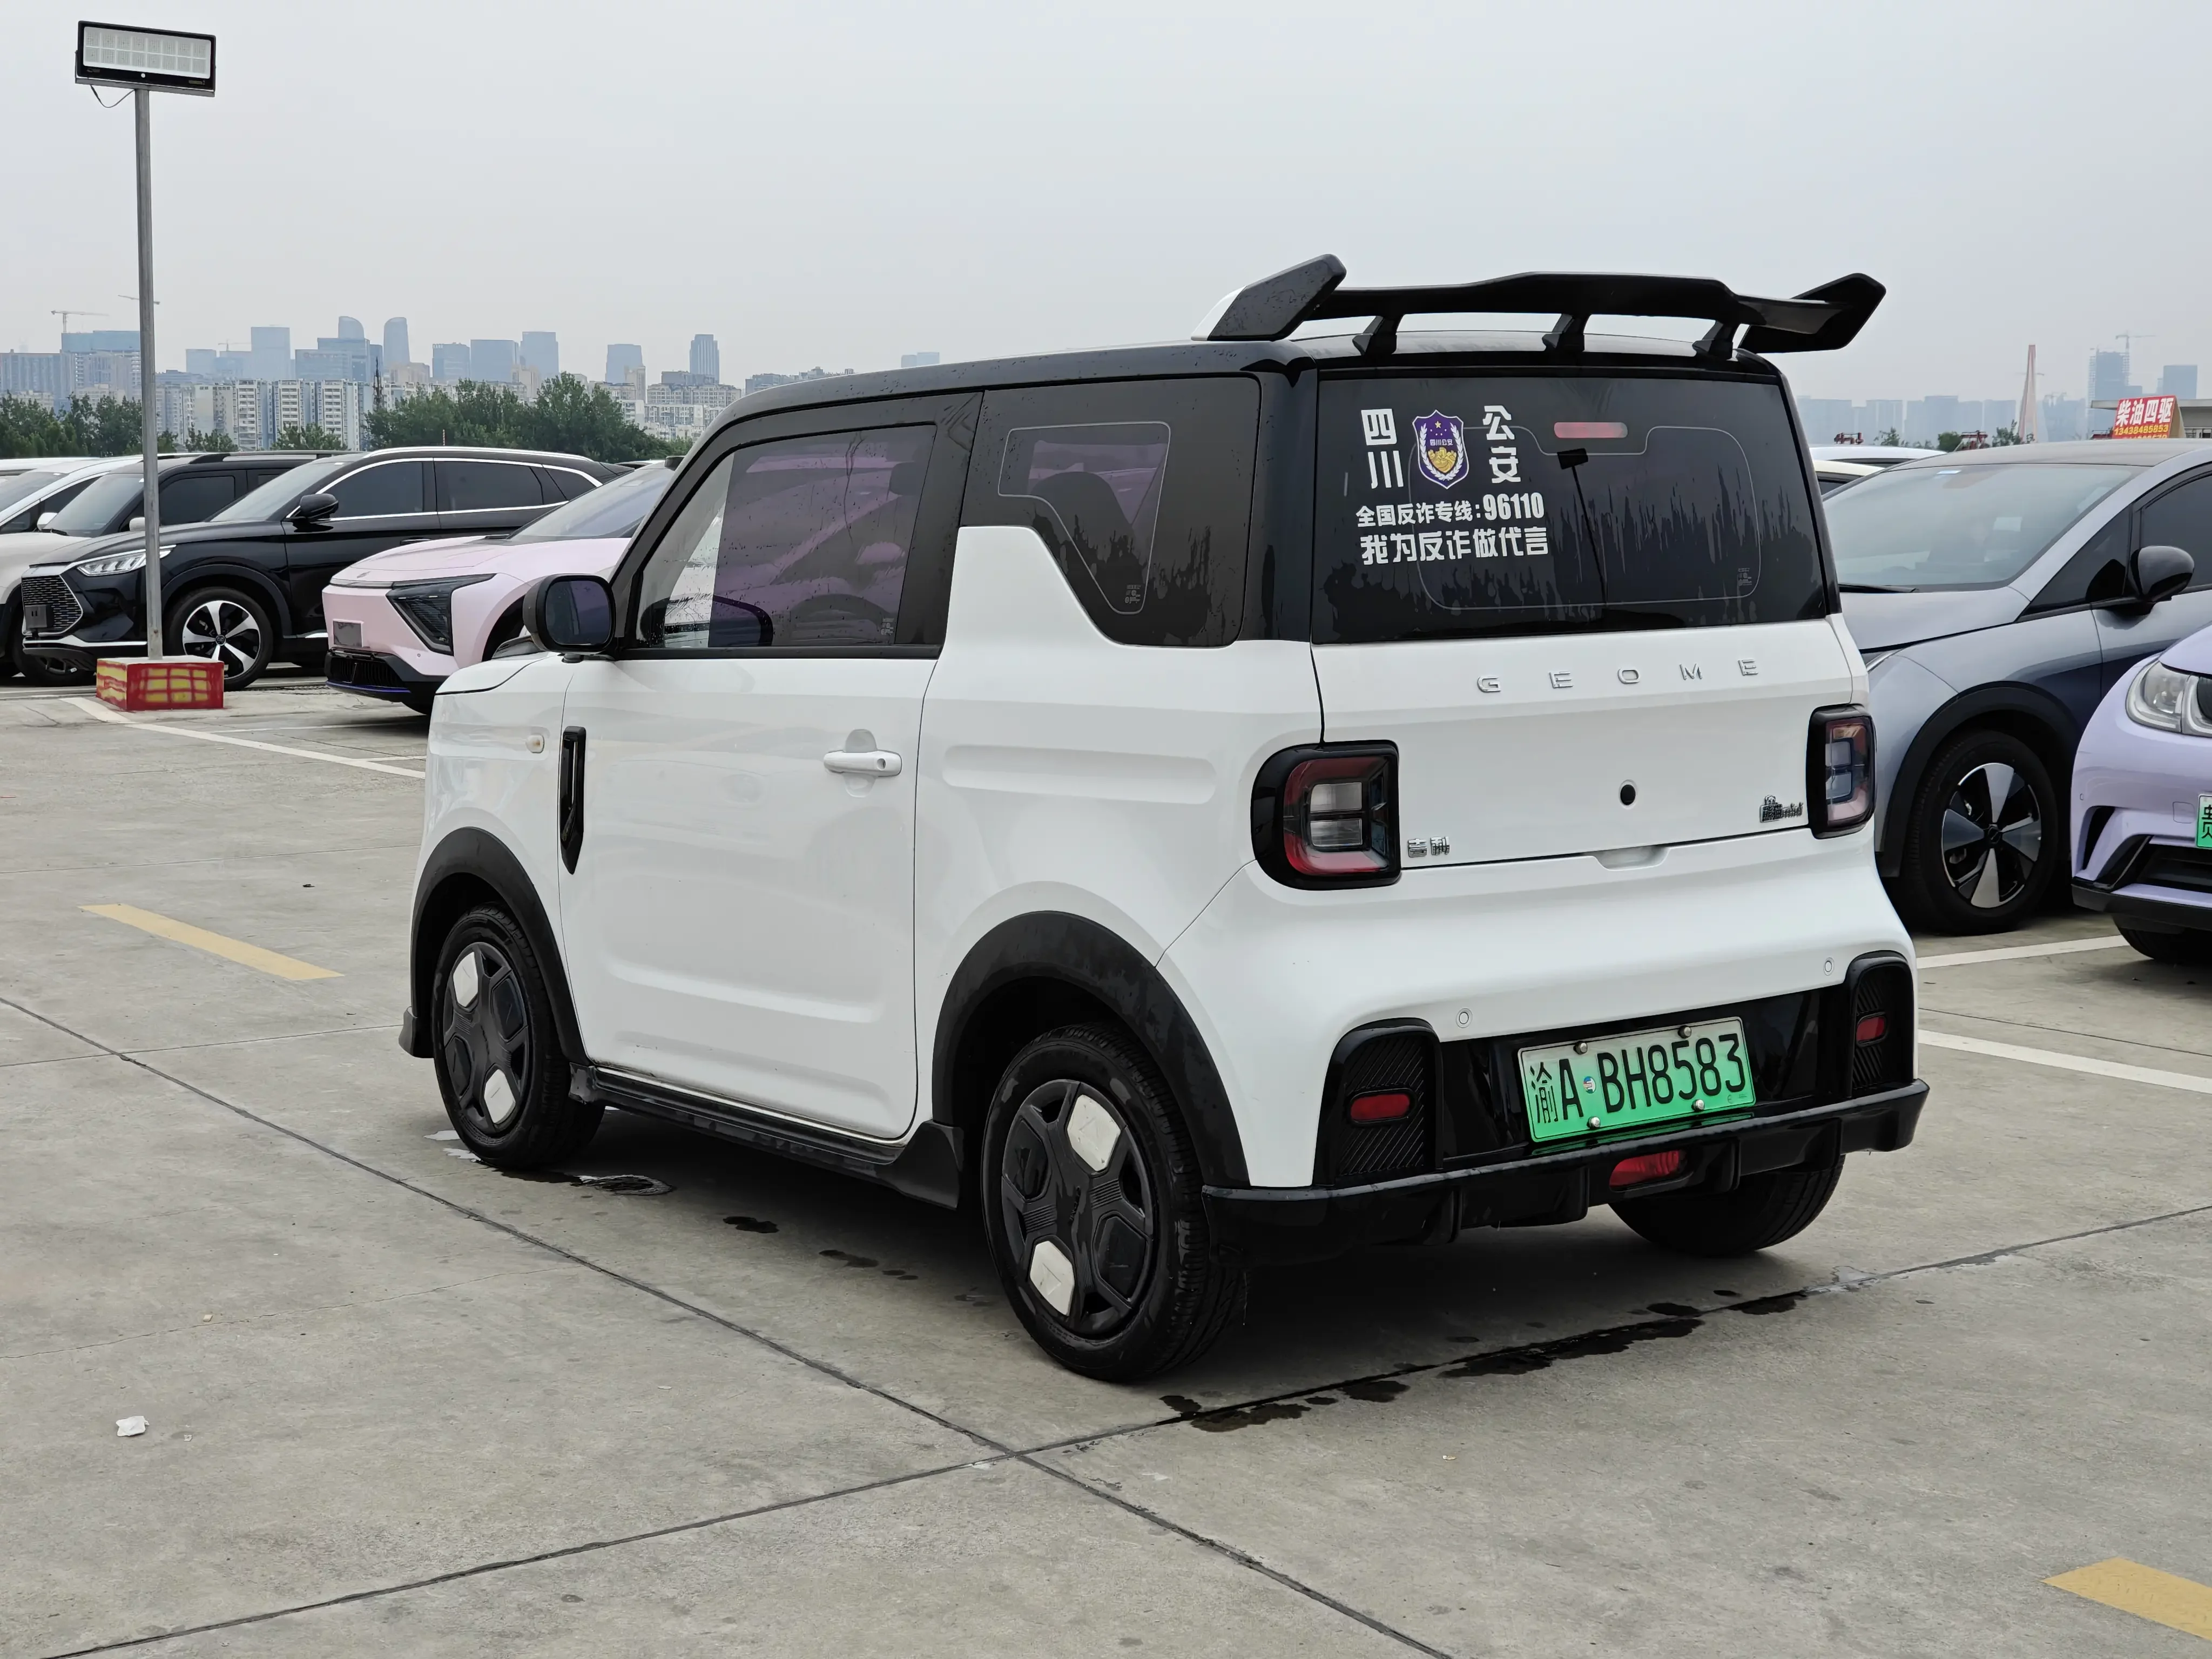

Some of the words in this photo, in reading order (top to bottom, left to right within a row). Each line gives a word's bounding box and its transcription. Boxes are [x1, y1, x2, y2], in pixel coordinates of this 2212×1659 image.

[2116, 397, 2174, 427] 柴油四驱
[1361, 409, 1404, 489] 四川
[1483, 406, 1521, 483] 公安
[1360, 527, 1548, 565] 我为反诈做代言
[1477, 659, 1759, 692] GEOME
[1407, 837, 1450, 858] 吉利
